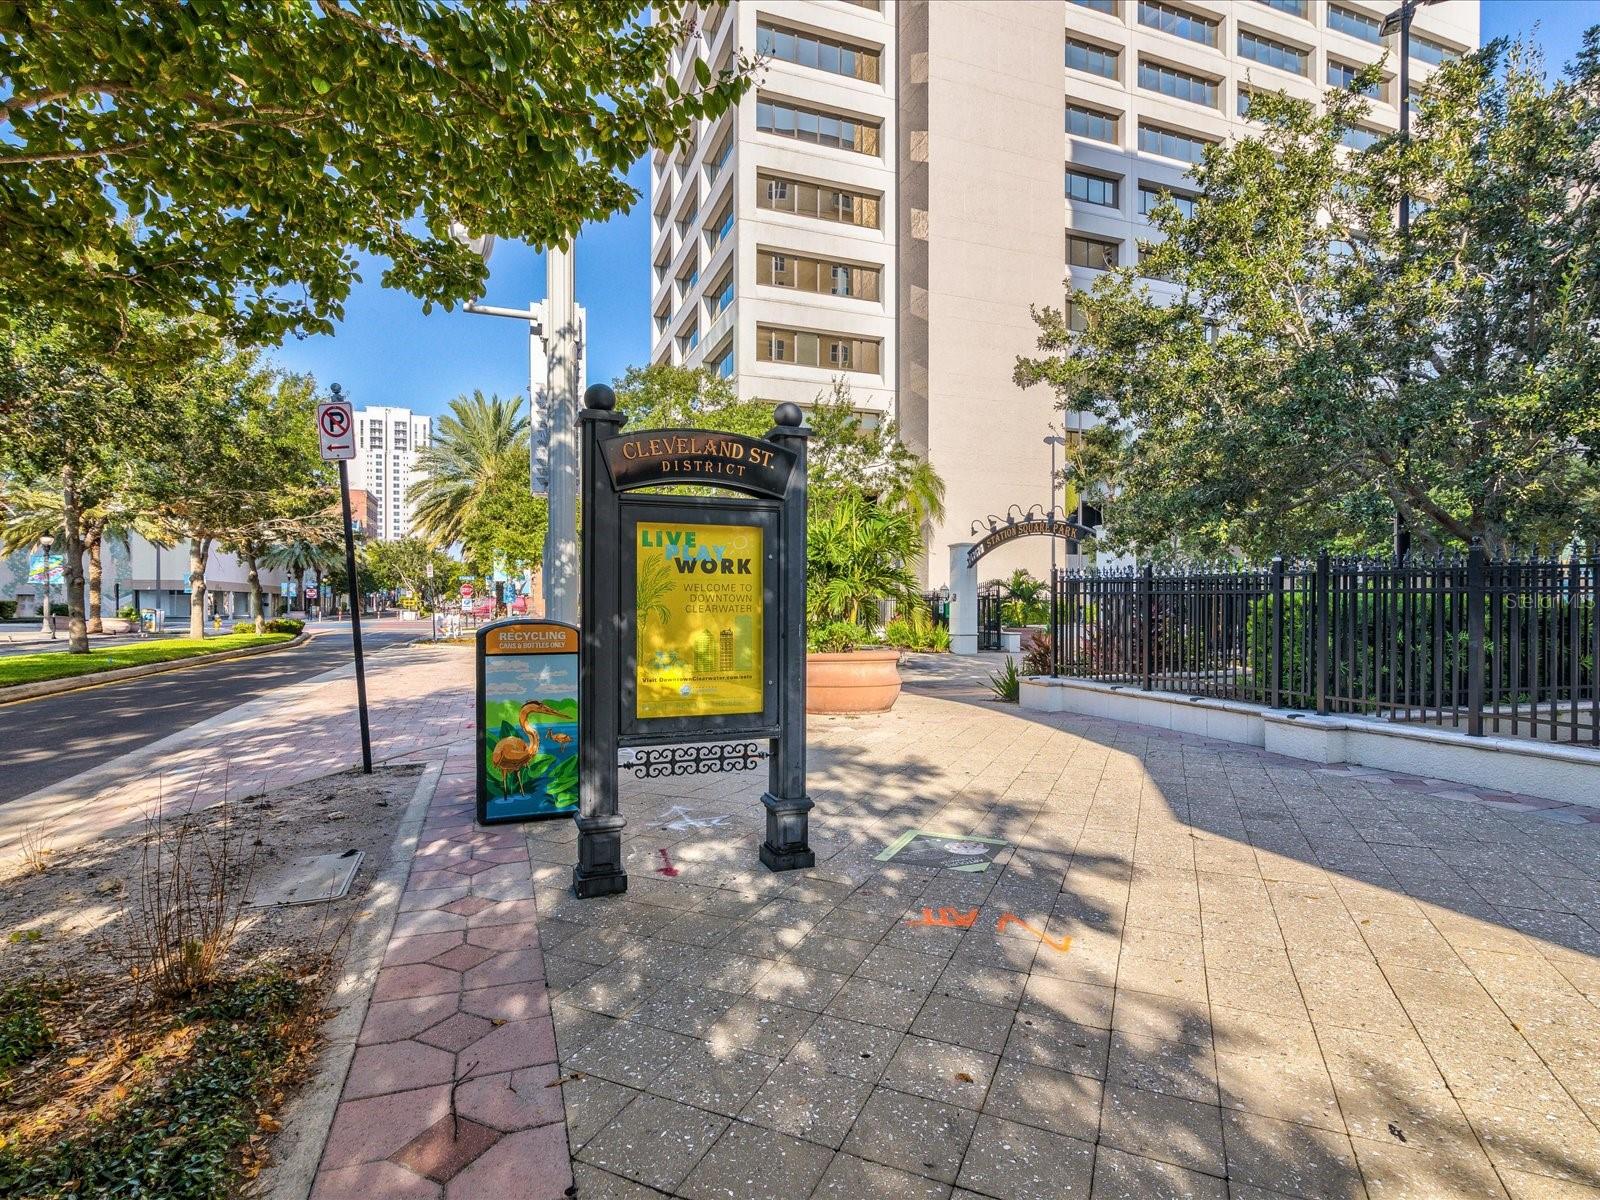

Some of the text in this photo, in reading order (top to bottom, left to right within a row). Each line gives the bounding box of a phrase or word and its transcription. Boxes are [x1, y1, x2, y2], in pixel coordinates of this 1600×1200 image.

[622, 436, 775, 470] CLEVELAND ST.
[662, 460, 746, 477] DISTRICT
[641, 530, 696, 548] LIVE
[986, 522, 1078, 548] STATION SQUARE PARK
[664, 543, 728, 561] PLAY
[674, 557, 752, 575] WORK
[683, 583, 752, 592] WELCOME TO
[689, 593, 752, 603] DOWNTOWN
[685, 604, 752, 614] CLEARWATER
[499, 631, 566, 641] RECYCLING
